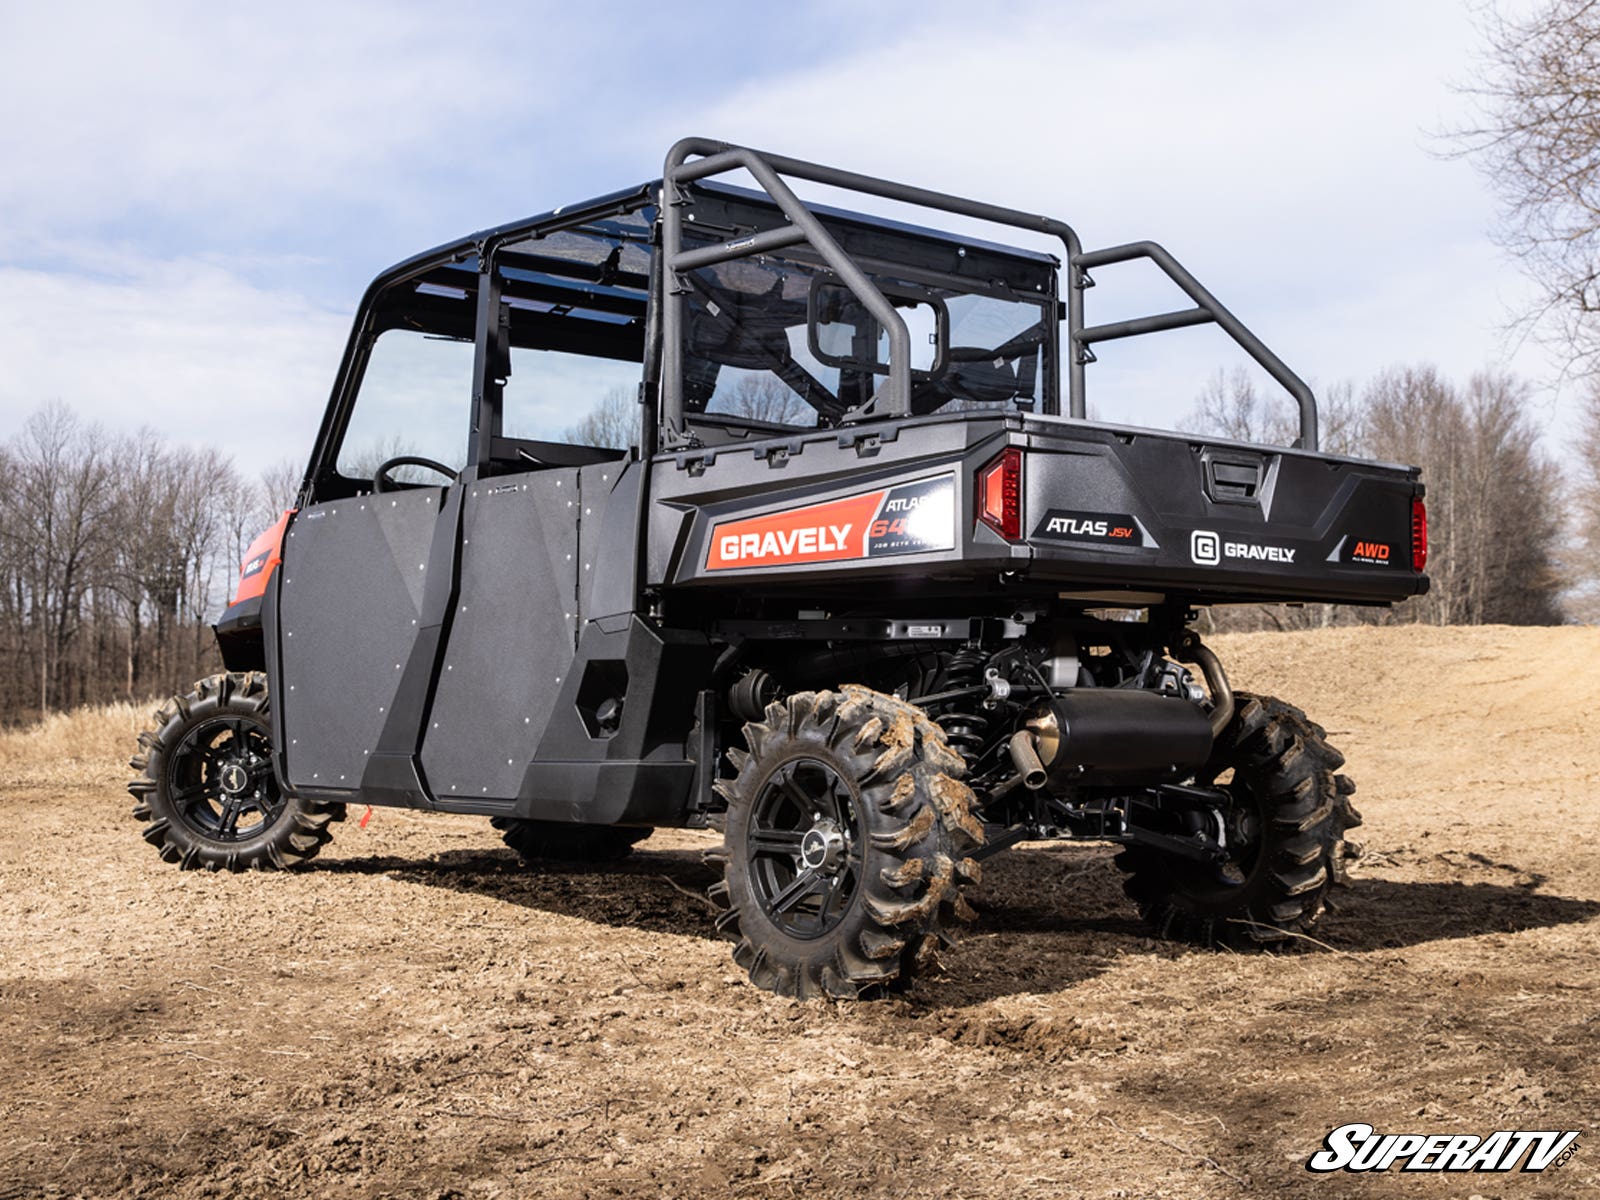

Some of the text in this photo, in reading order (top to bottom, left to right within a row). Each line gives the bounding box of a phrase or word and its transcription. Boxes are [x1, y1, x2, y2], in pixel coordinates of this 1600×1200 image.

[885, 497, 925, 512] ATLA
[1046, 517, 1133, 538] ATLAS JSV
[720, 523, 853, 560] GRAVELY
[1353, 541, 1390, 560] AWD
[1224, 542, 1296, 563] GRAVELY
